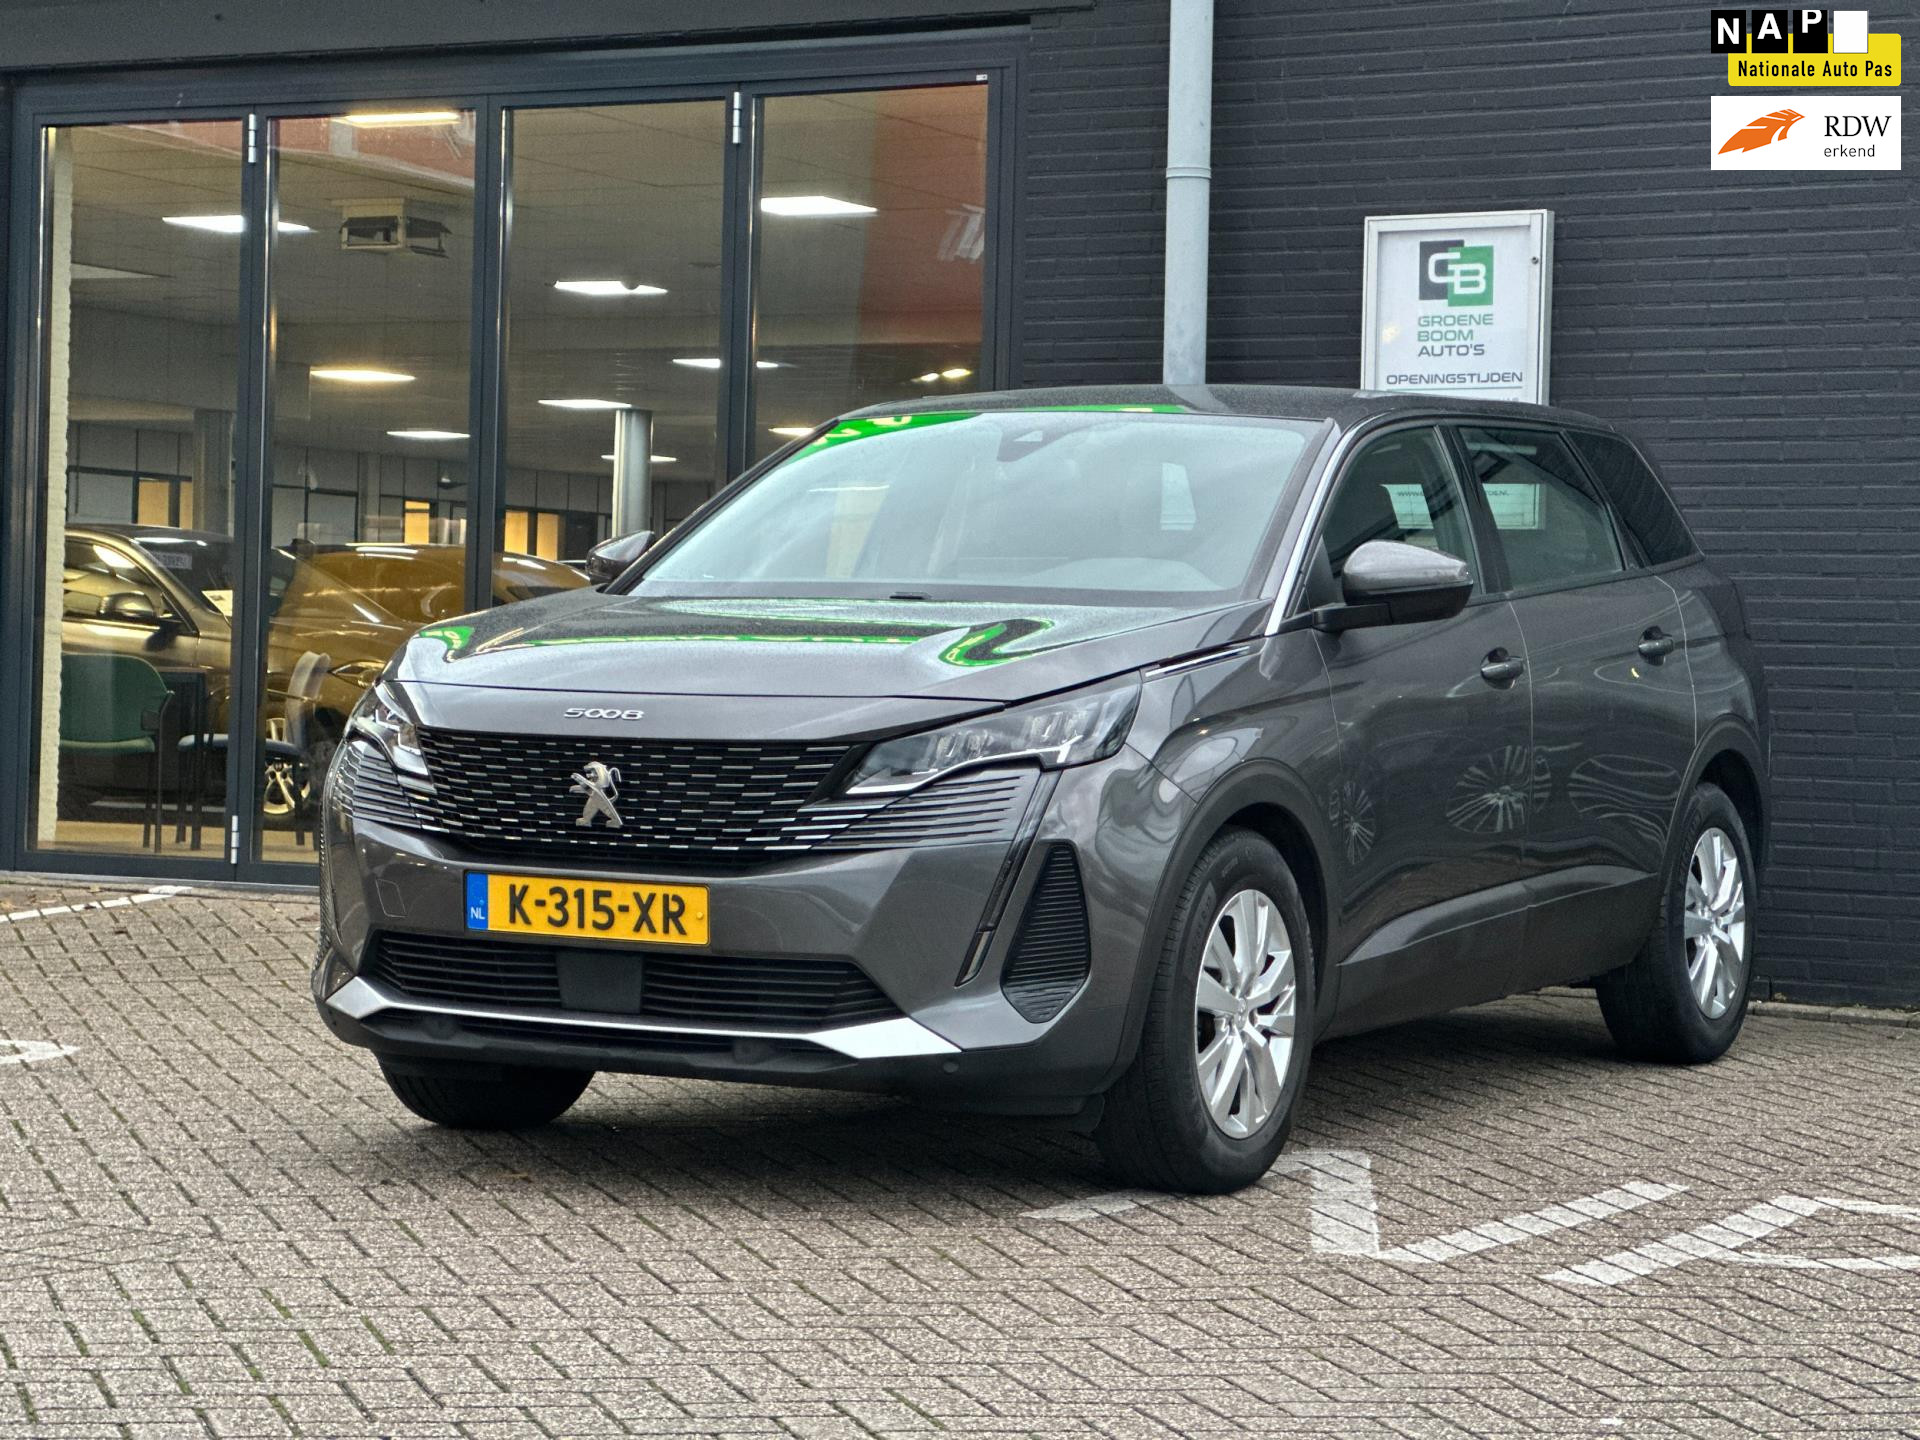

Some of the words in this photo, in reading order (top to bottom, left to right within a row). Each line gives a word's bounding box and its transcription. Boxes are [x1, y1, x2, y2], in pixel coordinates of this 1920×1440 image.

[1417, 313, 1494, 327] GROENE
[1417, 329, 1474, 342] BOOM
[1417, 344, 1485, 357] AUTO'S
[1386, 371, 1523, 385] OPENINGSTIJDEN
[563, 708, 645, 721] 5008
[470, 906, 486, 920] NL
[508, 883, 687, 936] K-315-XR
